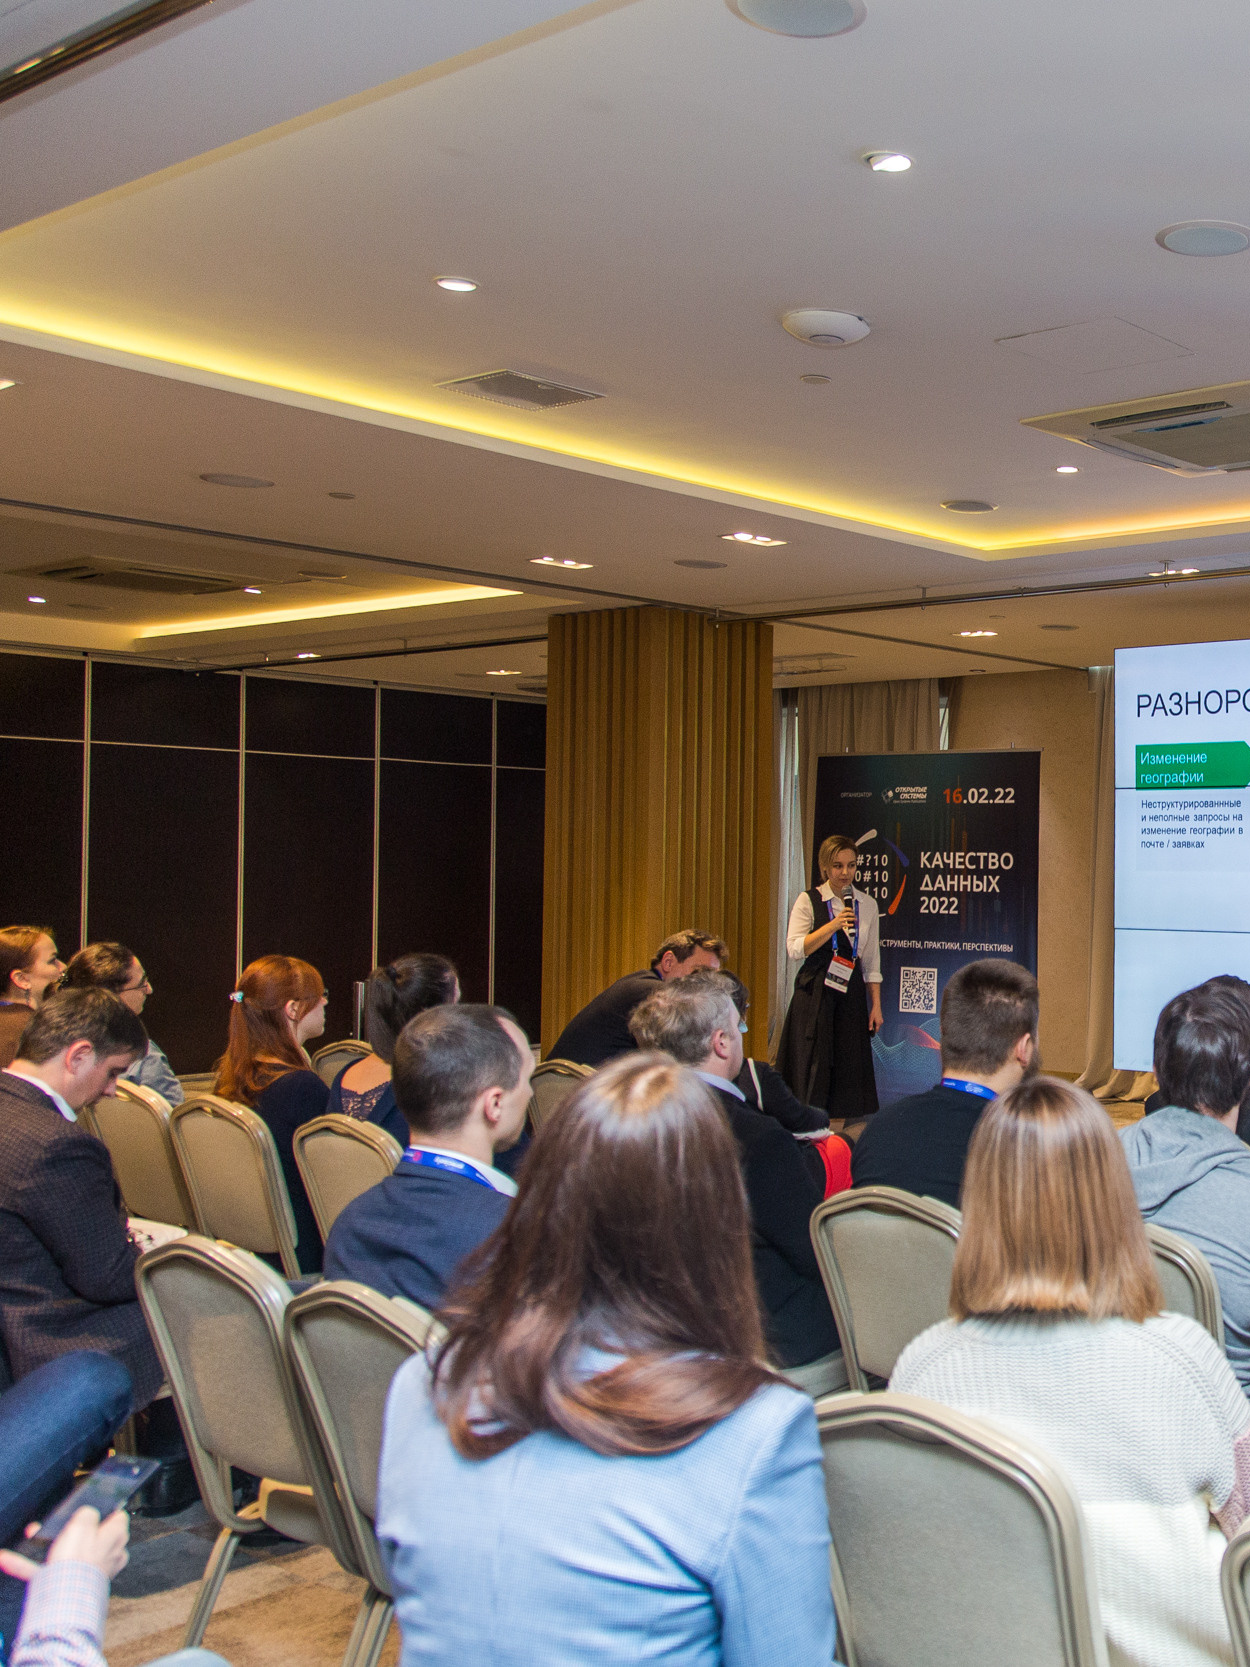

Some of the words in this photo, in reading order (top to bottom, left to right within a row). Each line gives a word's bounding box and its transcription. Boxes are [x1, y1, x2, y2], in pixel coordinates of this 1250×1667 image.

[1140, 752, 1208, 766] Изменение
[1140, 770, 1204, 786] географии
[943, 787, 1015, 804] 16.02.22
[1141, 814, 1147, 822] и
[1148, 813, 1190, 822] неполные
[1193, 813, 1230, 823] запросы
[1232, 813, 1243, 821] на
[1141, 826, 1187, 835] изменение
[1189, 825, 1235, 837] географии
[1238, 827, 1244, 835] в
[1140, 840, 1165, 848] почте
[1172, 840, 1205, 848] заявках
[920, 851, 1014, 870] КАЧЕСТВО
[920, 874, 1000, 893] ДАННЫХ
[920, 897, 958, 914] 2022
[924, 940, 961, 951] ПРАКТИКИ,
[962, 942, 1014, 953] ПЕРСПЕКТИВЫ
